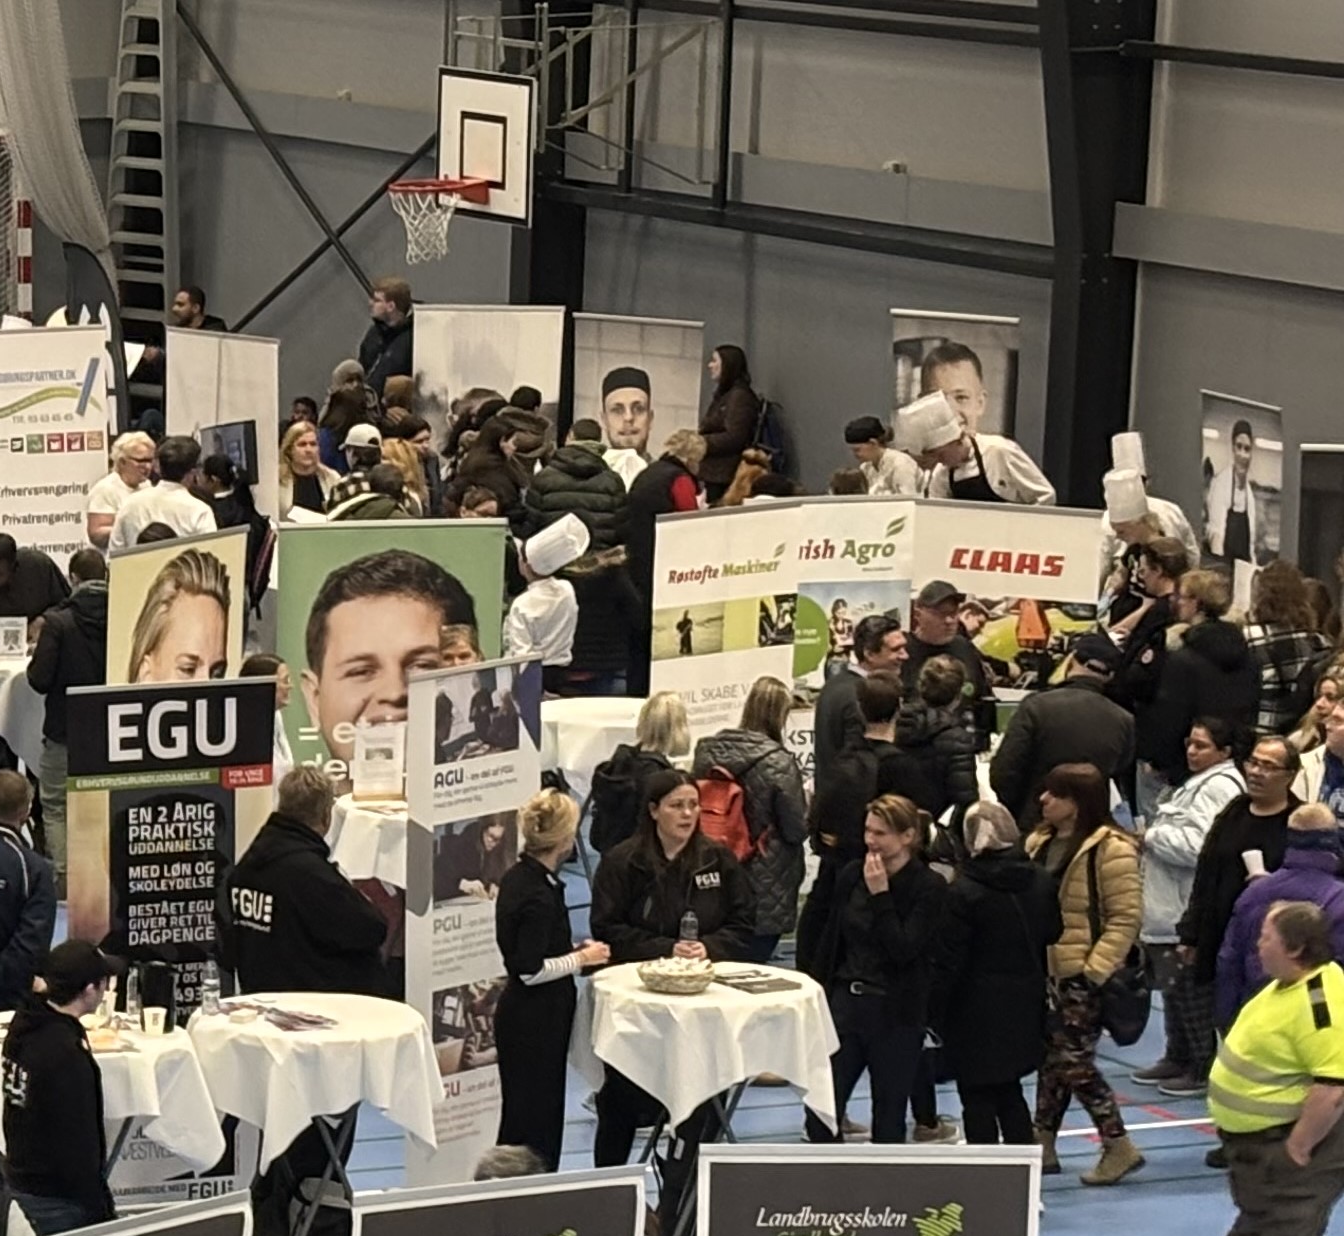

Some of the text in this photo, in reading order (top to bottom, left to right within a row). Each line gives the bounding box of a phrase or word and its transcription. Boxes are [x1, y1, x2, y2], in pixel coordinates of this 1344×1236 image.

[840, 537, 896, 566] Agro
[949, 546, 1066, 578] CLAAS
[668, 558, 781, 586] Røstofte Maskiner
[106, 696, 238, 763] EGU
[433, 767, 463, 789] AGU
[128, 801, 216, 826] EN 2 ÅRIG
[128, 822, 217, 842] PRAKTISK
[128, 837, 216, 856] UDDANNELSE
[128, 860, 216, 880] MED LØN OG
[128, 875, 216, 894] SKOLEYDELSE
[128, 898, 216, 917] BESTÅET EGU
[128, 912, 197, 930] GIVER RET
[128, 927, 217, 947] DAGPENGE
[754, 1205, 909, 1236] Landbrugsskolen
